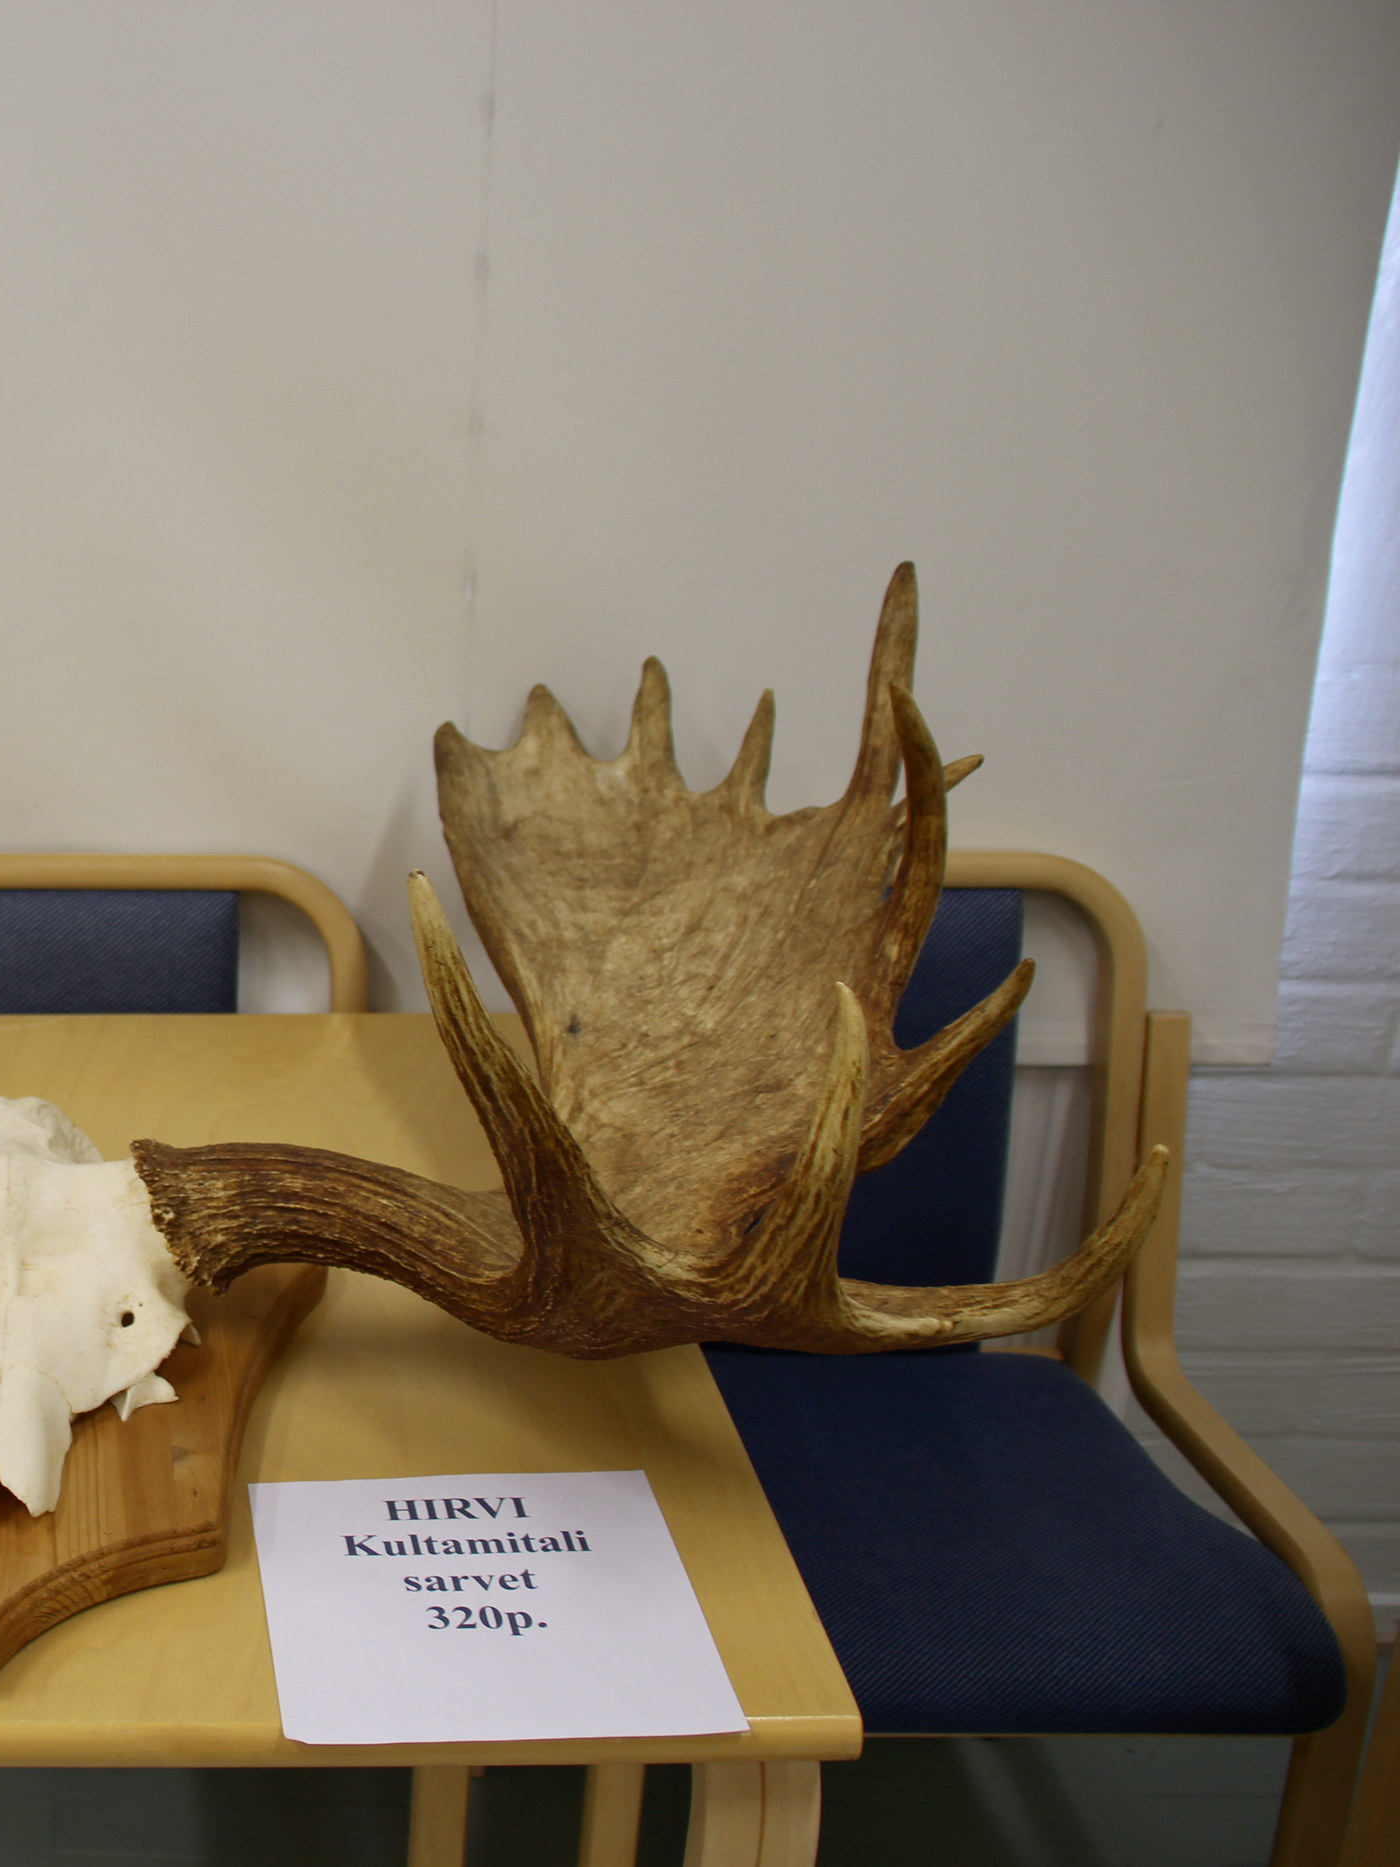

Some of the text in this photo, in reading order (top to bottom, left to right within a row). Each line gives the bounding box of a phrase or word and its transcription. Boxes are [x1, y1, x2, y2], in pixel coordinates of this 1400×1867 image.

[383, 1497, 531, 1521] HIRVI
[340, 1530, 592, 1557] Kultamitali
[403, 1569, 538, 1592] sarvet
[426, 1605, 548, 1637] 320p.
